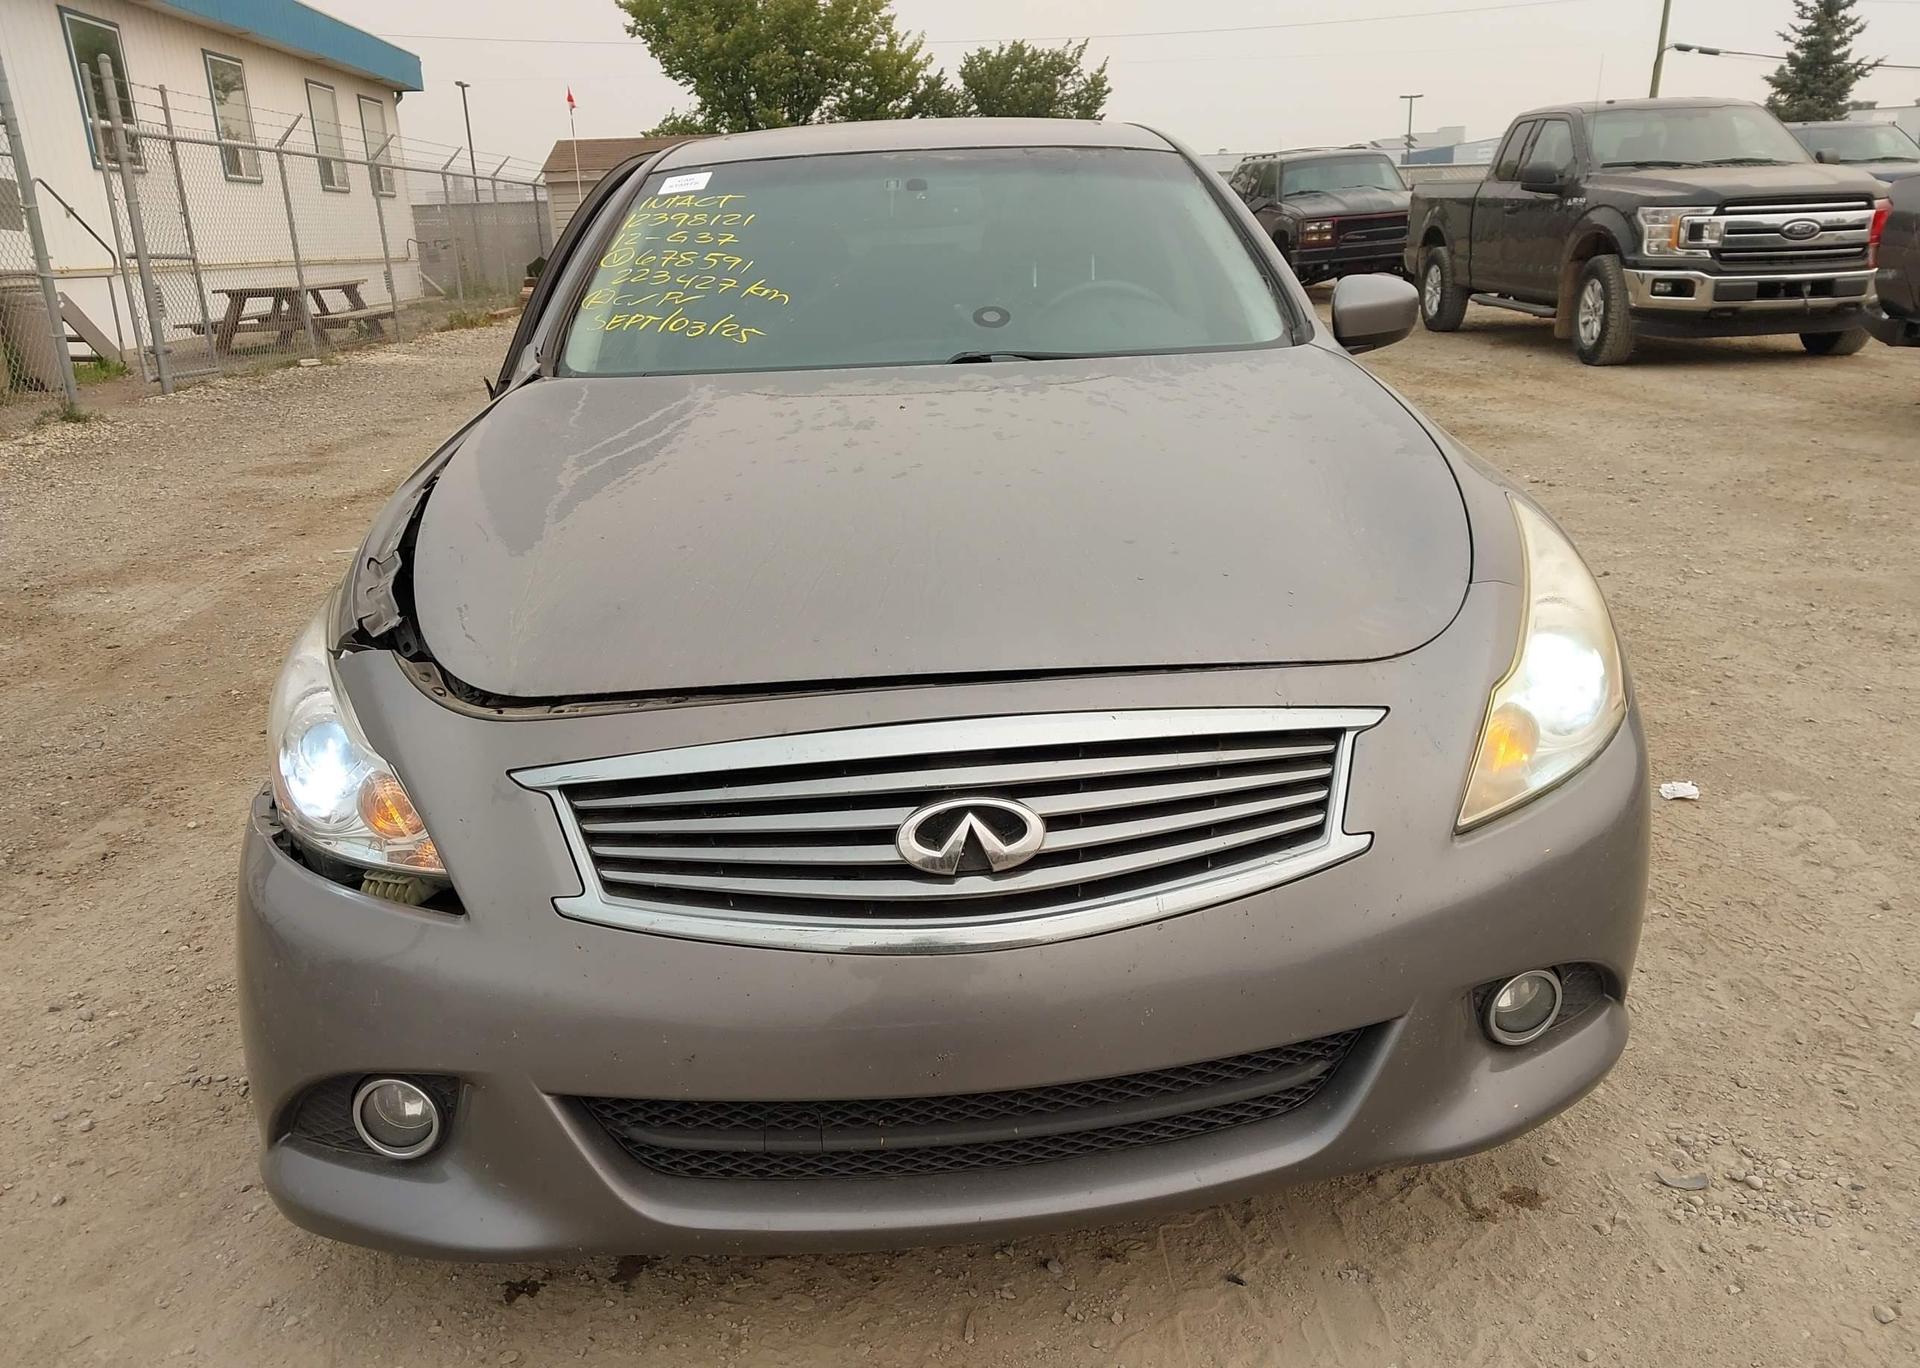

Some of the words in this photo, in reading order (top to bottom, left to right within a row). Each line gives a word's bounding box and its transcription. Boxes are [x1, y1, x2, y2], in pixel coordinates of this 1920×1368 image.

[639, 195, 747, 209] INTACT
[635, 249, 754, 274] 678591
[611, 268, 740, 294] 223427
